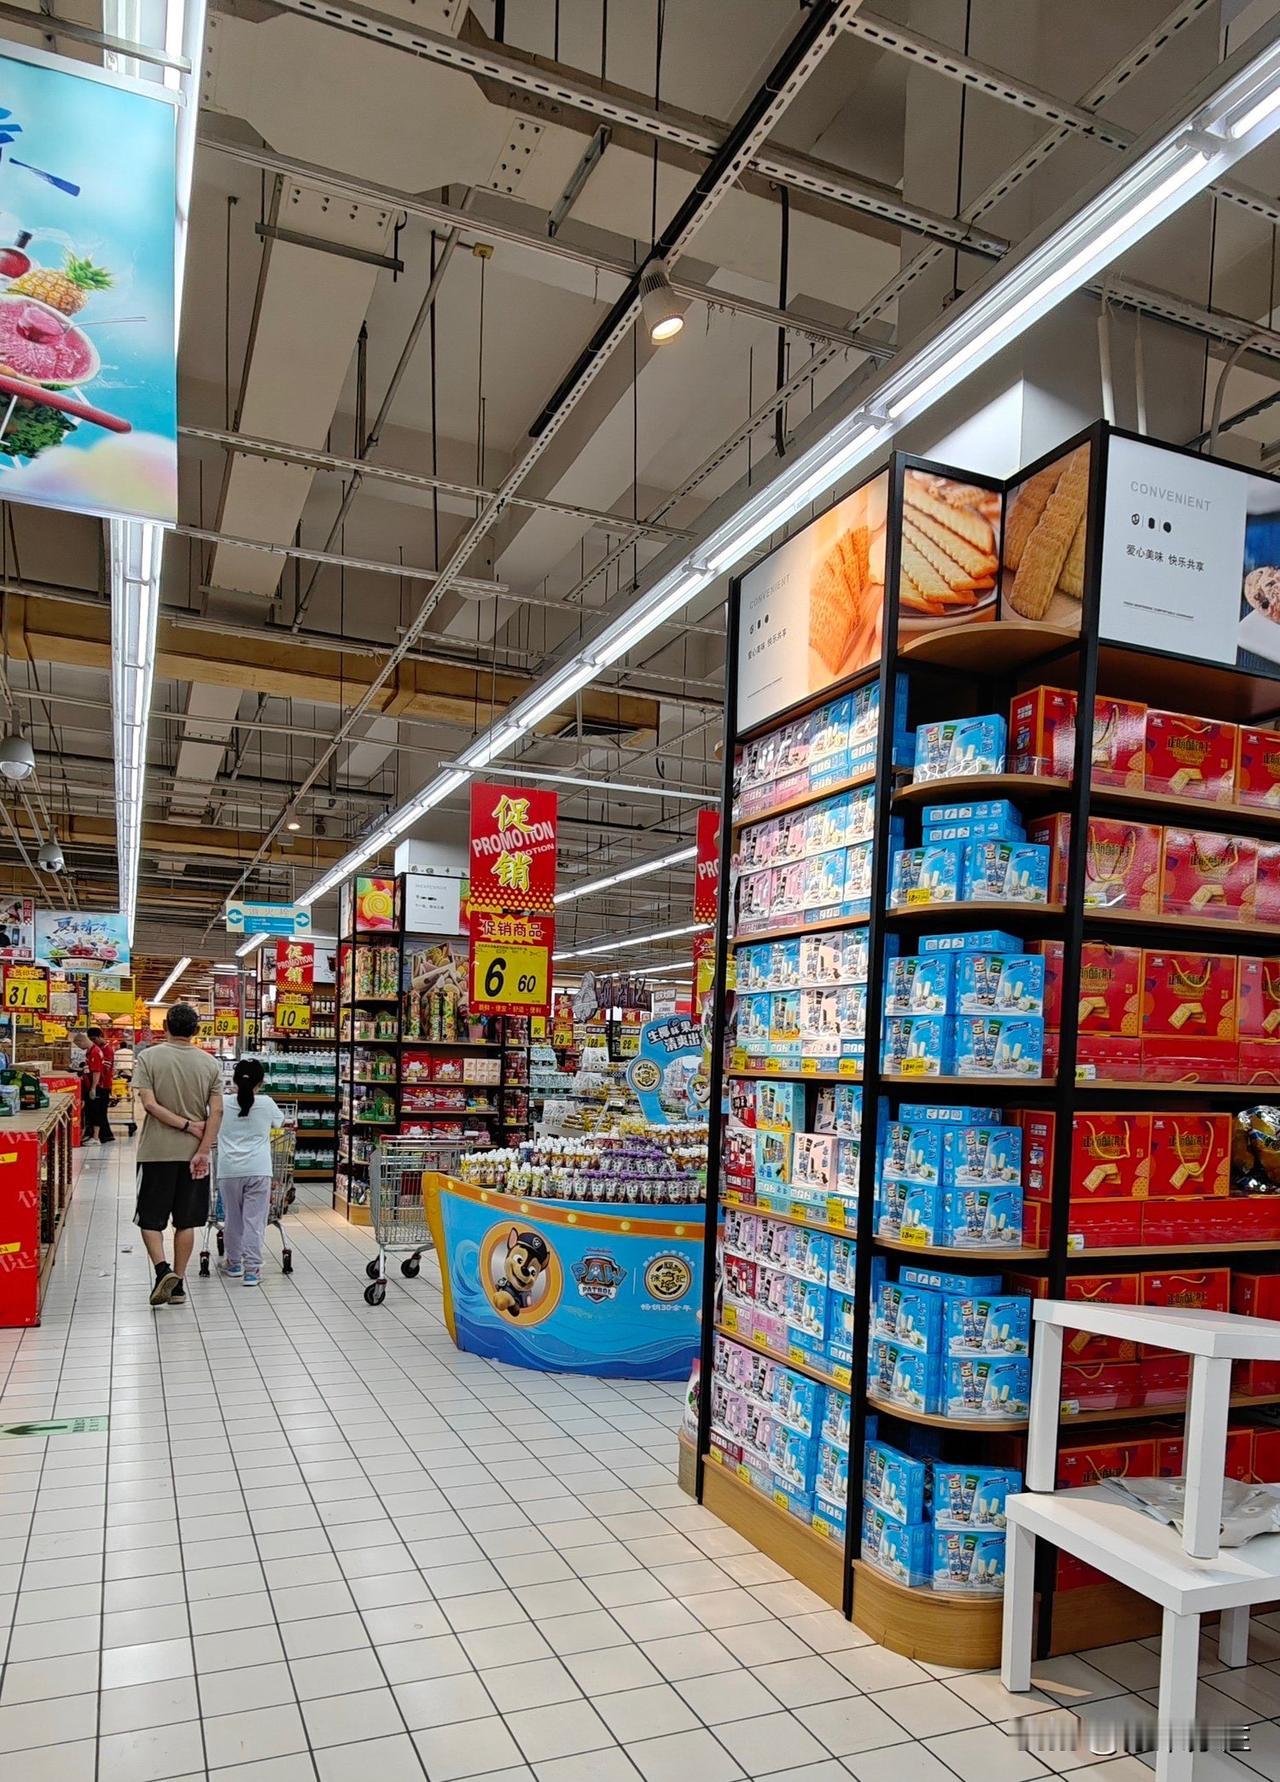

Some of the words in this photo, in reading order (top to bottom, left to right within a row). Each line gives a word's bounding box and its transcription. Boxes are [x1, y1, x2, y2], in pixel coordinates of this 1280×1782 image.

[1130, 481, 1211, 511] CONVENIENT
[1126, 544, 1164, 563] 爱心美味
[1168, 553, 1205, 572] 快乐共享
[749, 574, 791, 609] CONVENIENT
[491, 794, 536, 832] 促
[472, 821, 555, 858] PROMOTION
[490, 850, 533, 892] 销
[483, 920, 542, 937] 促销商品
[277, 955, 313, 969] PROMOTION
[485, 957, 507, 997] 6
[518, 974, 536, 993] 60
[9, 986, 28, 1005] 31
[281, 1010, 296, 1026] 10
[570, 1260, 627, 1286] PAW
[582, 1286, 613, 1296] PATROL
